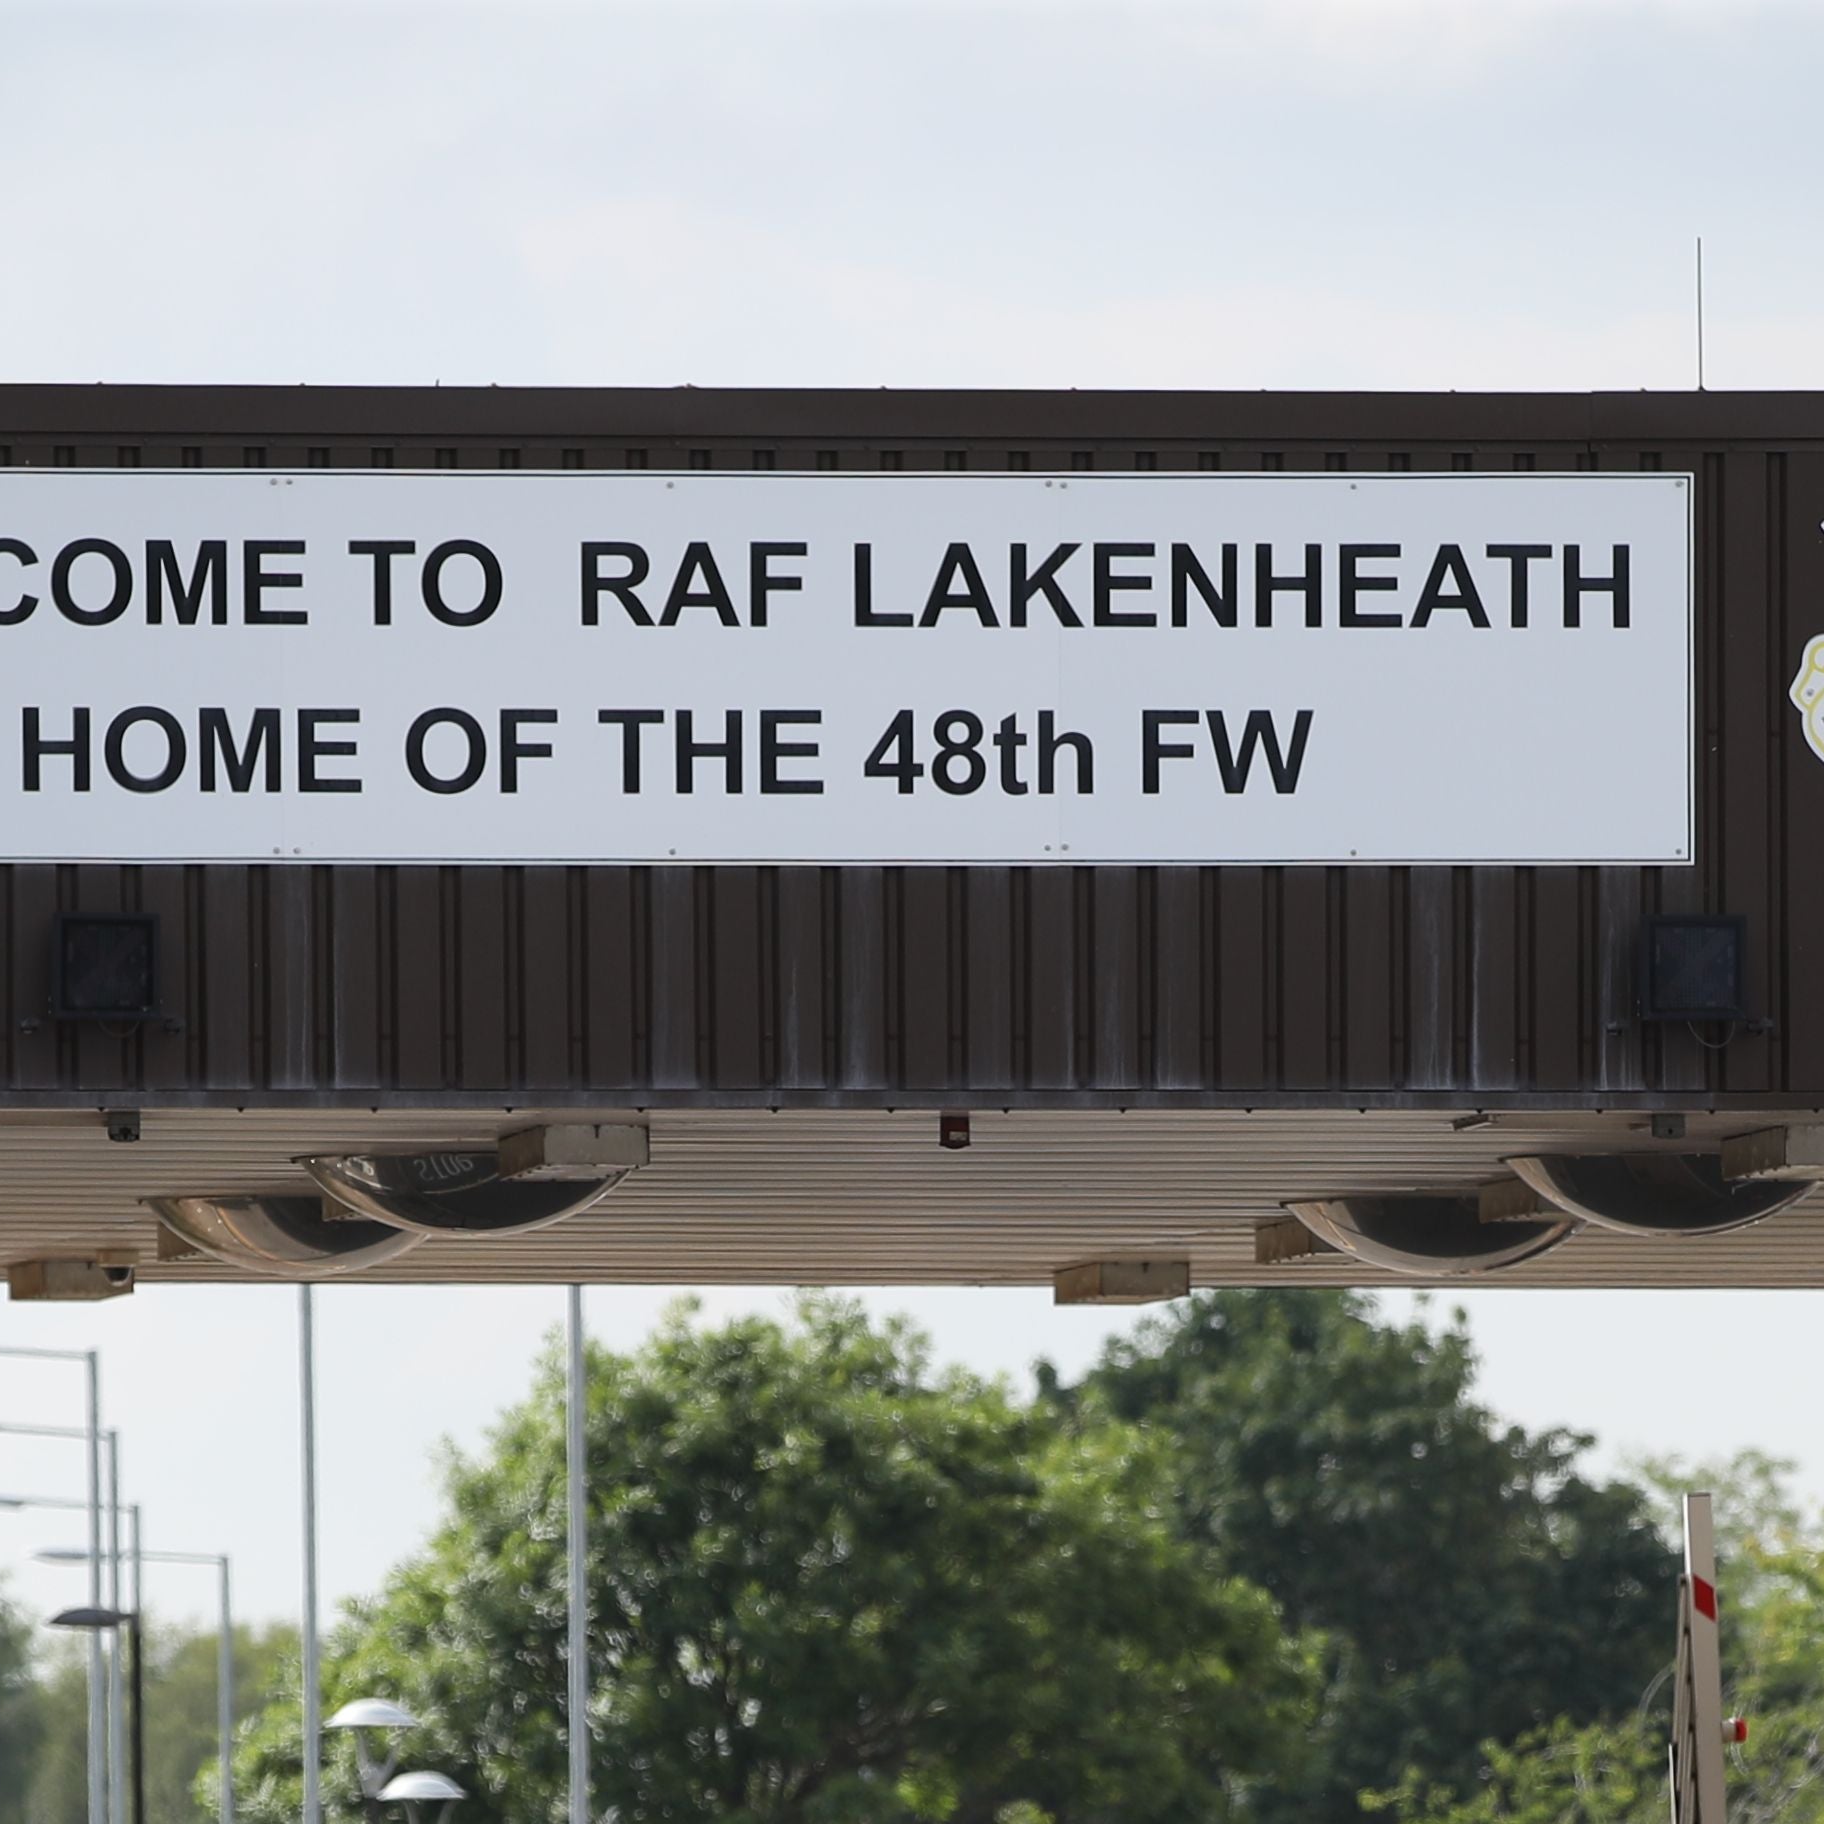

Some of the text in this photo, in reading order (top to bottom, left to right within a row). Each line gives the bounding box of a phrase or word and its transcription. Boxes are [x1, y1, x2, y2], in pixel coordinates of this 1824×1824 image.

[349, 540, 502, 626] TO
[582, 542, 807, 626] RAF
[855, 543, 1629, 628] LAKENHEATH
[23, 706, 1313, 795] HOME OF THE 48th FW
